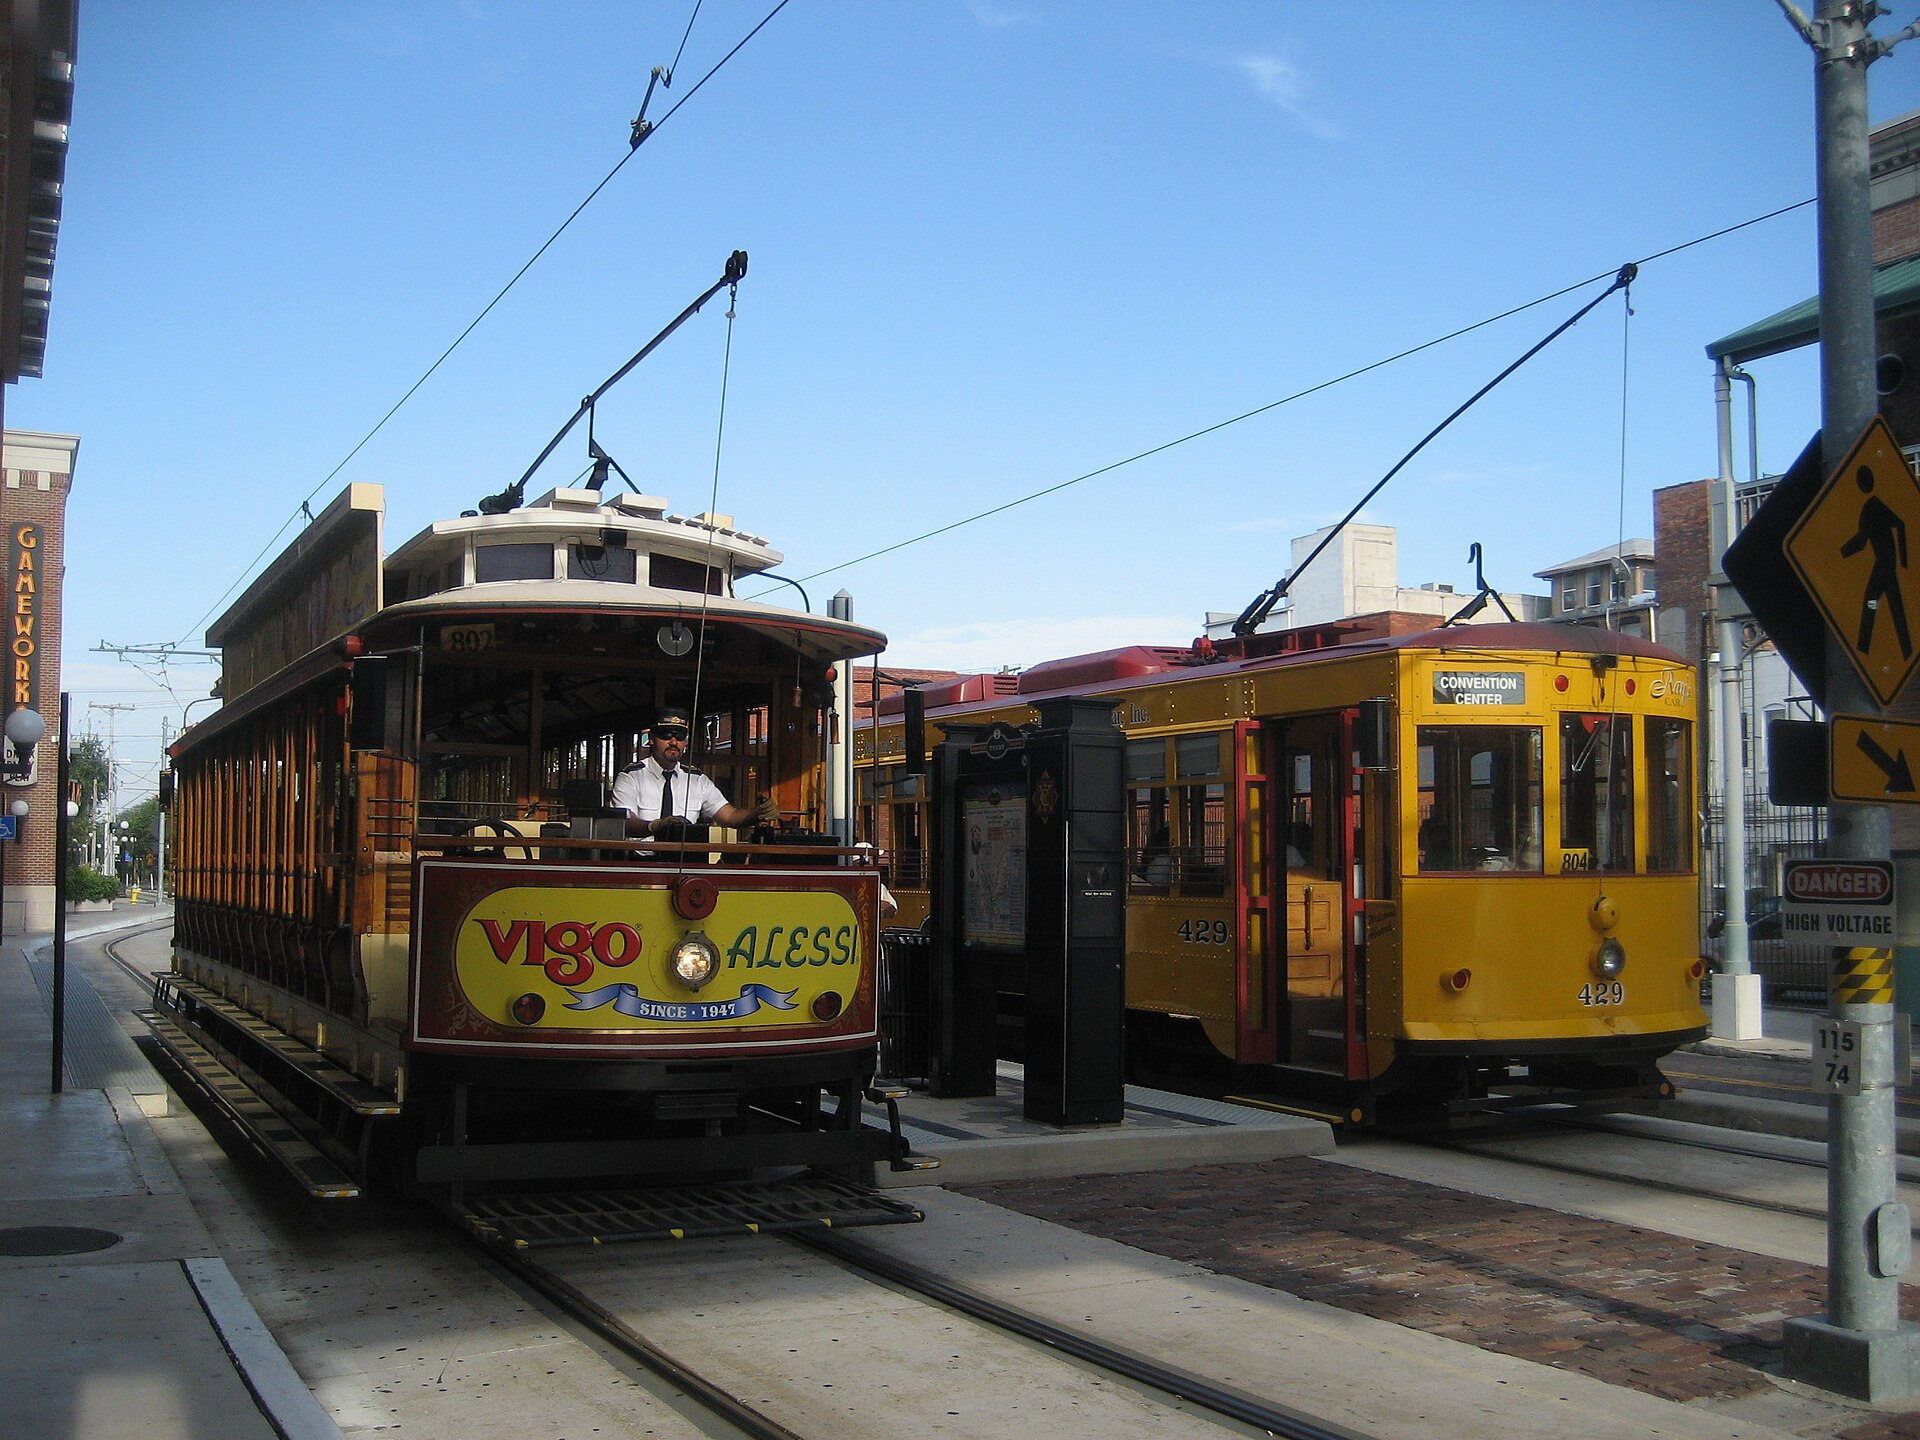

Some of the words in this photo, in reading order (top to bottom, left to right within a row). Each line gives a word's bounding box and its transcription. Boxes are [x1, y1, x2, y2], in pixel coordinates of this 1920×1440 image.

[12, 525, 38, 711] GAMEWORK
[1440, 676, 1517, 690] CONVENTION
[1455, 693, 1503, 705] CENTER
[1129, 703, 1151, 724] Inc.
[1562, 851, 1588, 871] 804
[1794, 872, 1881, 893] DANGER
[1177, 918, 1230, 946] 429
[1785, 913, 1820, 931] HIGH
[1826, 914, 1892, 934] VOLTAGE
[726, 924, 858, 968] ALESSI
[1577, 981, 1625, 1006] 429
[640, 1002, 687, 1019] SINCE
[701, 1003, 736, 1018] 1947
[1819, 1028, 1854, 1052] 115
[1825, 1063, 1850, 1084] 74
